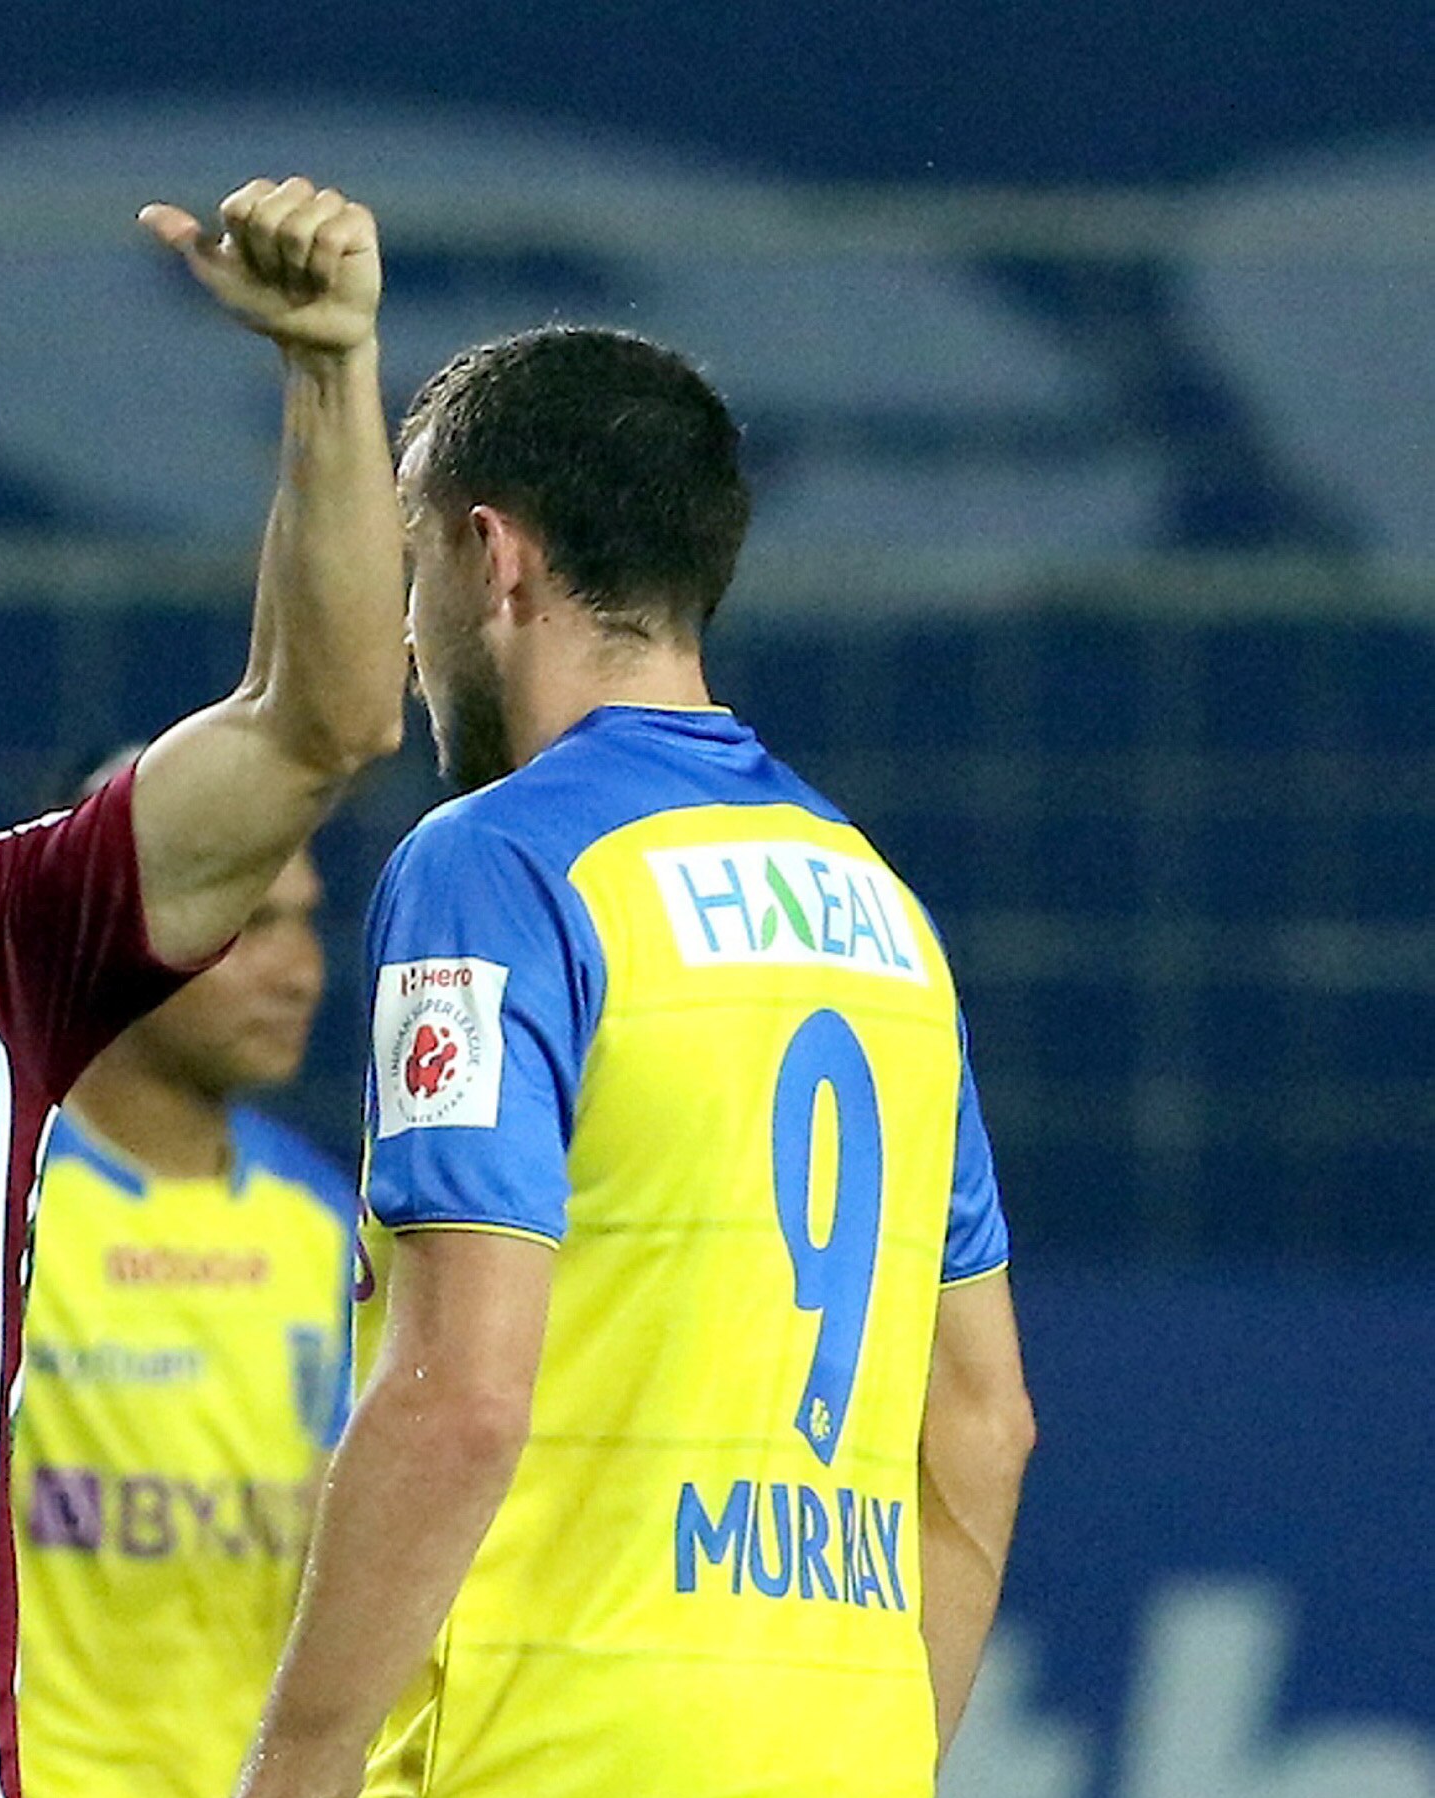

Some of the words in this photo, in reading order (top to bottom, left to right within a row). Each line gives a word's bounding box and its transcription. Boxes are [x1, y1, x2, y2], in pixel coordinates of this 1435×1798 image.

[421, 967, 473, 988] Hero
[772, 1008, 883, 1468] 9
[675, 1480, 907, 1612] MURRAY
